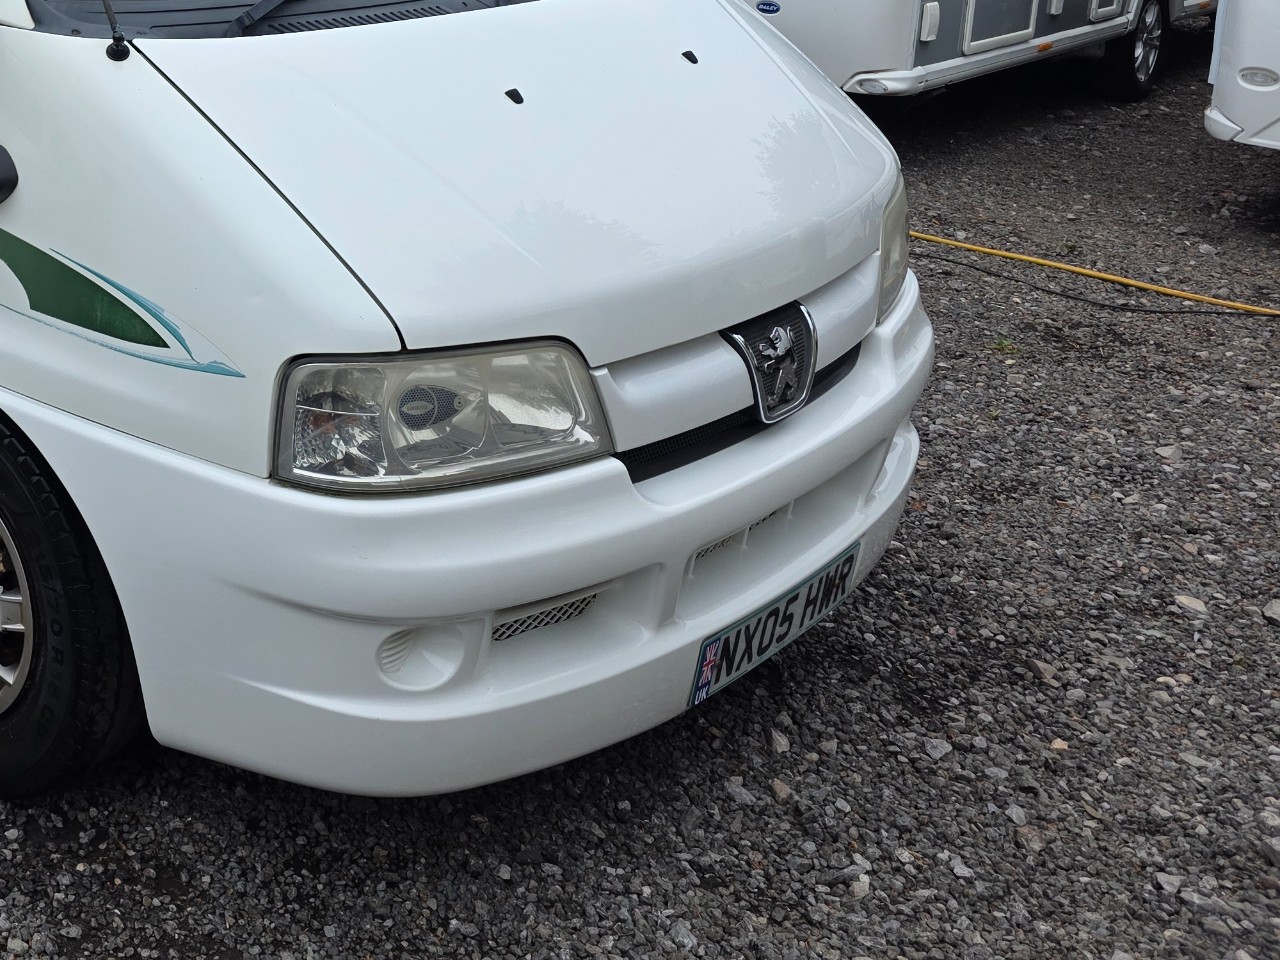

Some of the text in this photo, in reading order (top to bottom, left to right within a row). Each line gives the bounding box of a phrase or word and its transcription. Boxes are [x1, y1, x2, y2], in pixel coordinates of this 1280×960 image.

[713, 553, 855, 686] NX05 HWR
[694, 685, 708, 705] UK
